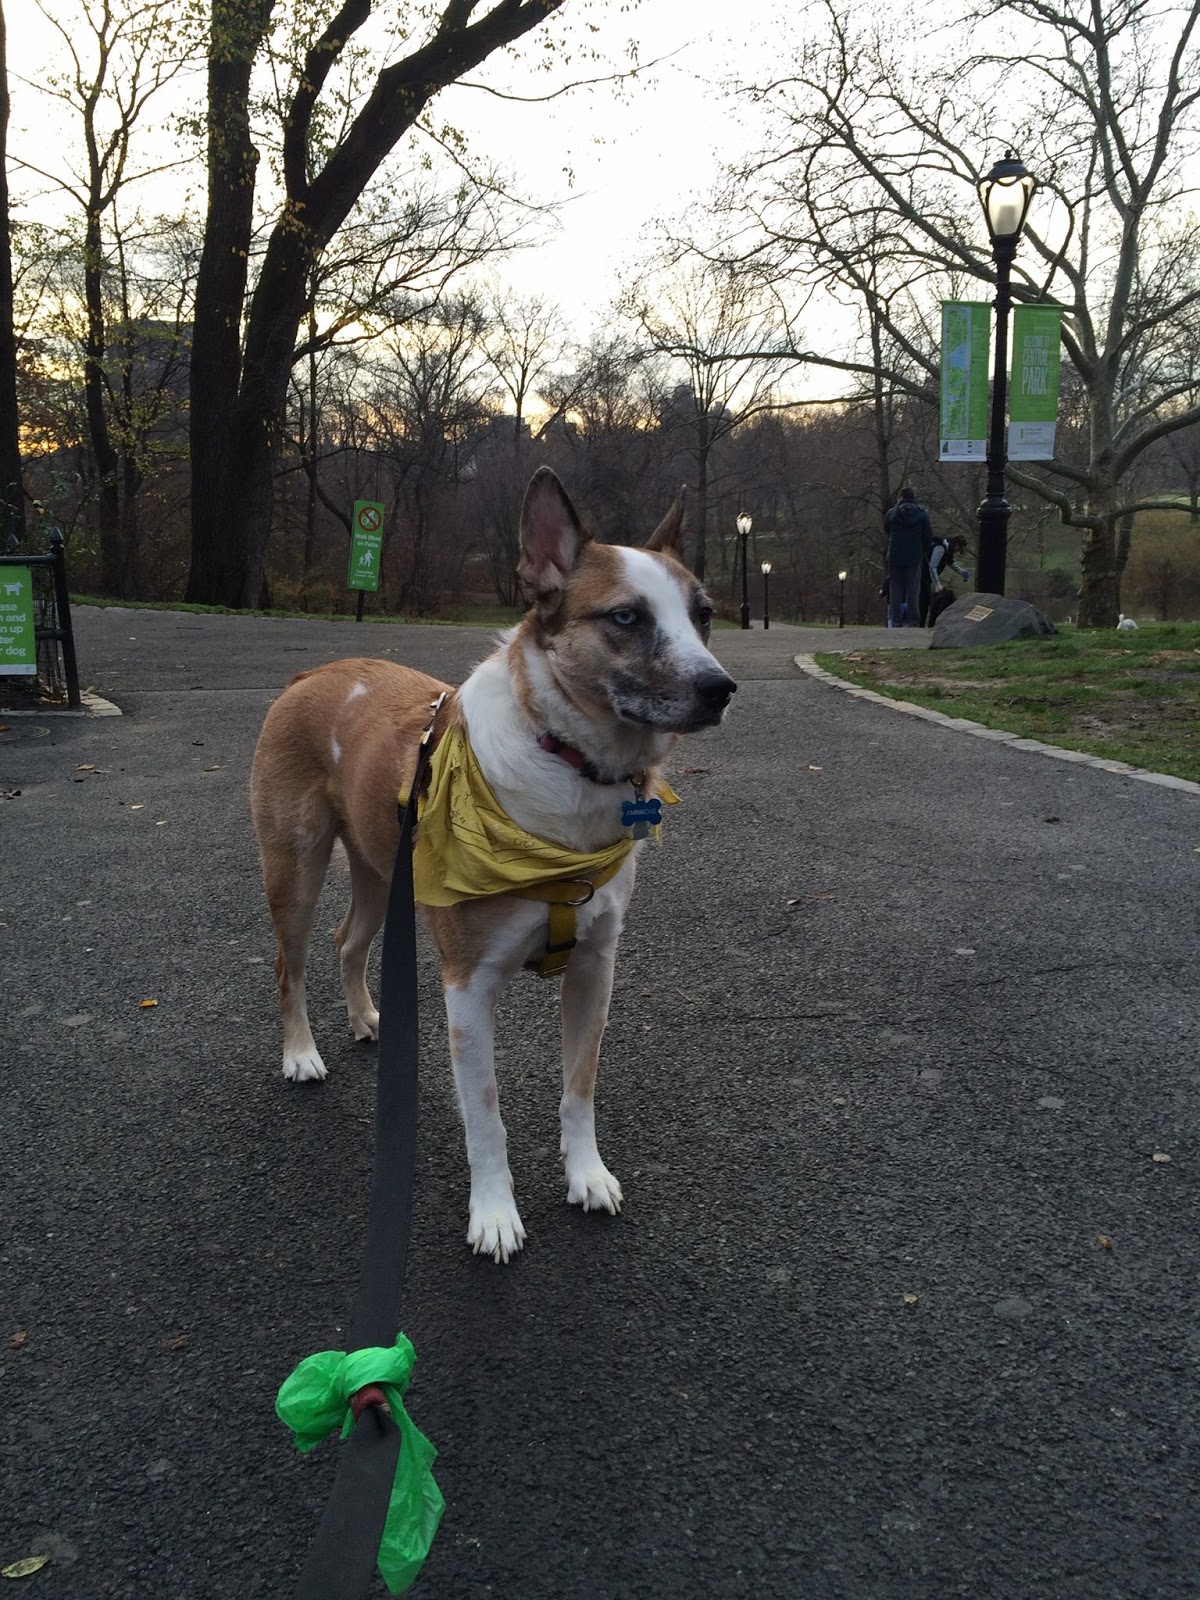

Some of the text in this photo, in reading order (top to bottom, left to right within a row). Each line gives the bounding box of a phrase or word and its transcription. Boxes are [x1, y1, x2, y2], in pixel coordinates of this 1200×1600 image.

[1023, 348, 1048, 366] CENTRAL
[1022, 366, 1049, 395] PARK
[6, 613, 26, 622] and
[10, 625, 23, 635] up
[5, 645, 26, 657] dog
